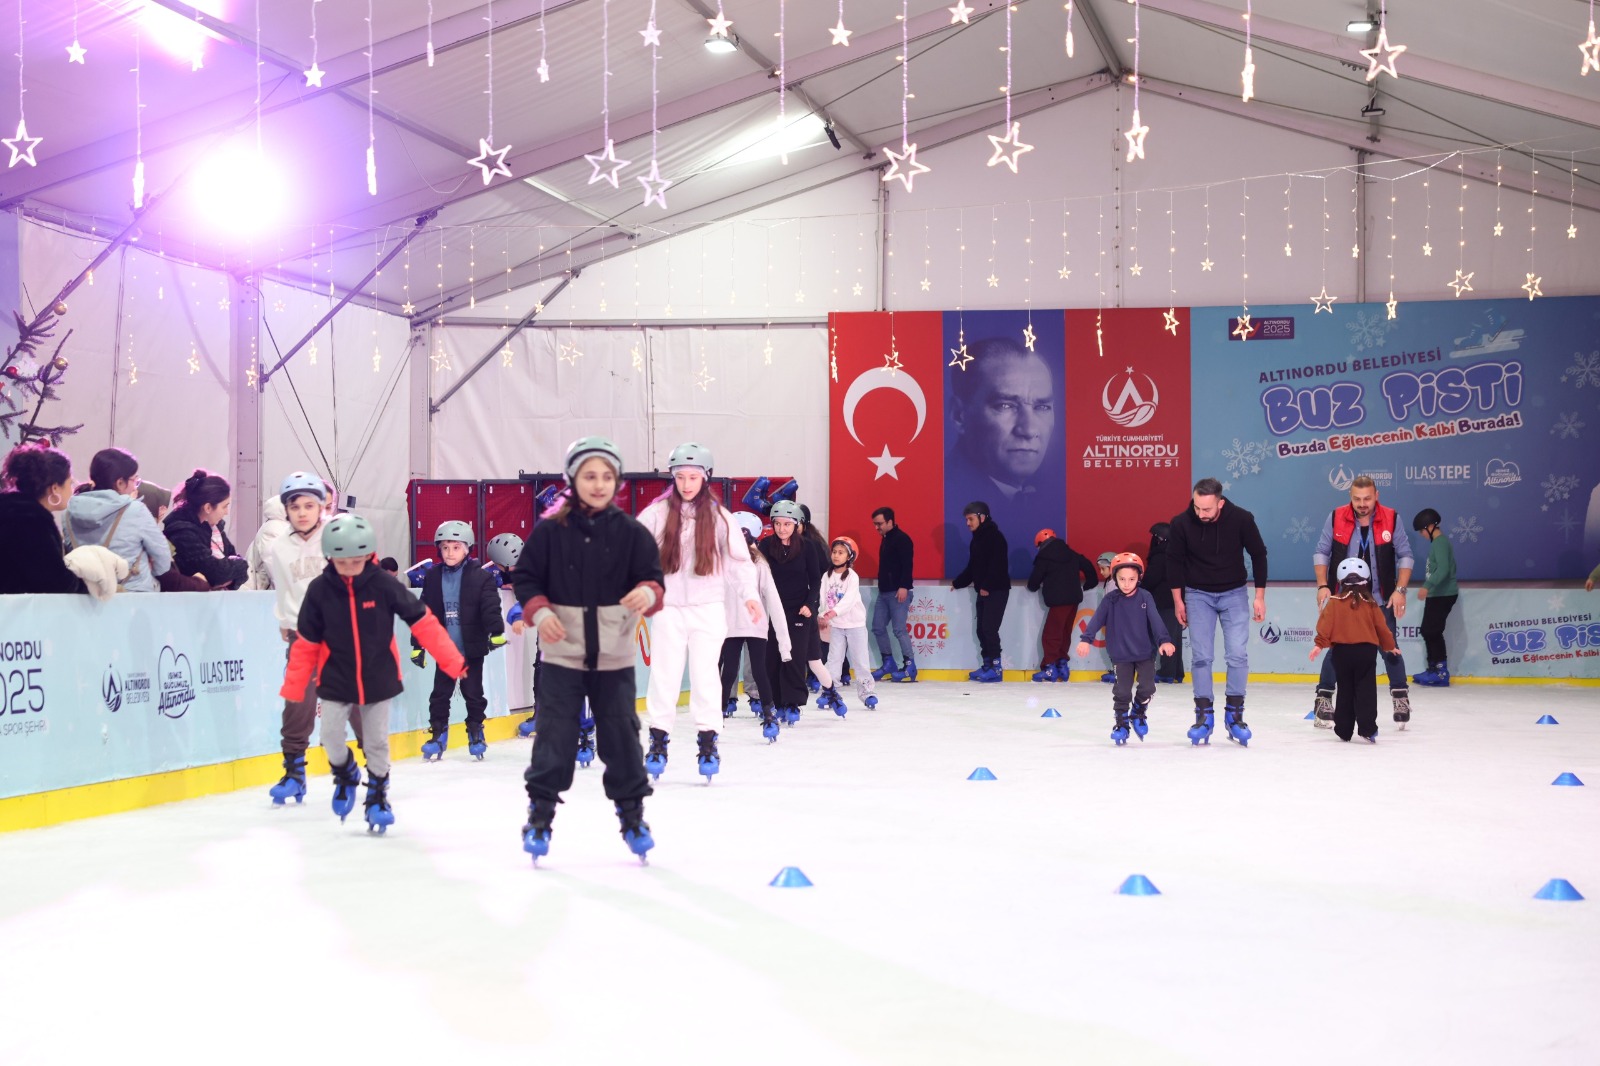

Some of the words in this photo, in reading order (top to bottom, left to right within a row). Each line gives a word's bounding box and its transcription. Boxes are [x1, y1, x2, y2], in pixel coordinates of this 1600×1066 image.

[1263, 325, 1291, 334] 2025
[1259, 361, 1348, 383] ALTINORDU
[1352, 346, 1442, 372] BELEDİYESİ
[1262, 384, 1365, 435] BUZ
[1095, 434, 1121, 442] TÜRKİYE
[1122, 433, 1164, 442] CUMHURİYETİ
[1277, 439, 1327, 457] Buzda
[1329, 428, 1413, 452] Eğlencenin
[1415, 422, 1456, 439] Kalbi
[1458, 412, 1521, 433] Burada!
[1082, 444, 1179, 458] ALTINORDU
[1083, 459, 1179, 468] BELEDİYESİ
[1405, 465, 1437, 481] ULAŞ
[1438, 464, 1471, 479] TEPE
[1489, 618, 1539, 630] ALTINORDU
[1541, 612, 1592, 625] BELEDİYESİ
[1402, 626, 1422, 638] TEP
[1485, 629, 1547, 656] BUZ
[1491, 655, 1521, 665] Buzda
[1522, 652, 1574, 663] Eğlencenin
[1575, 648, 1600, 658] Kalbi
[200, 661, 224, 685] ULAŞ
[223, 659, 245, 682] TEPE
